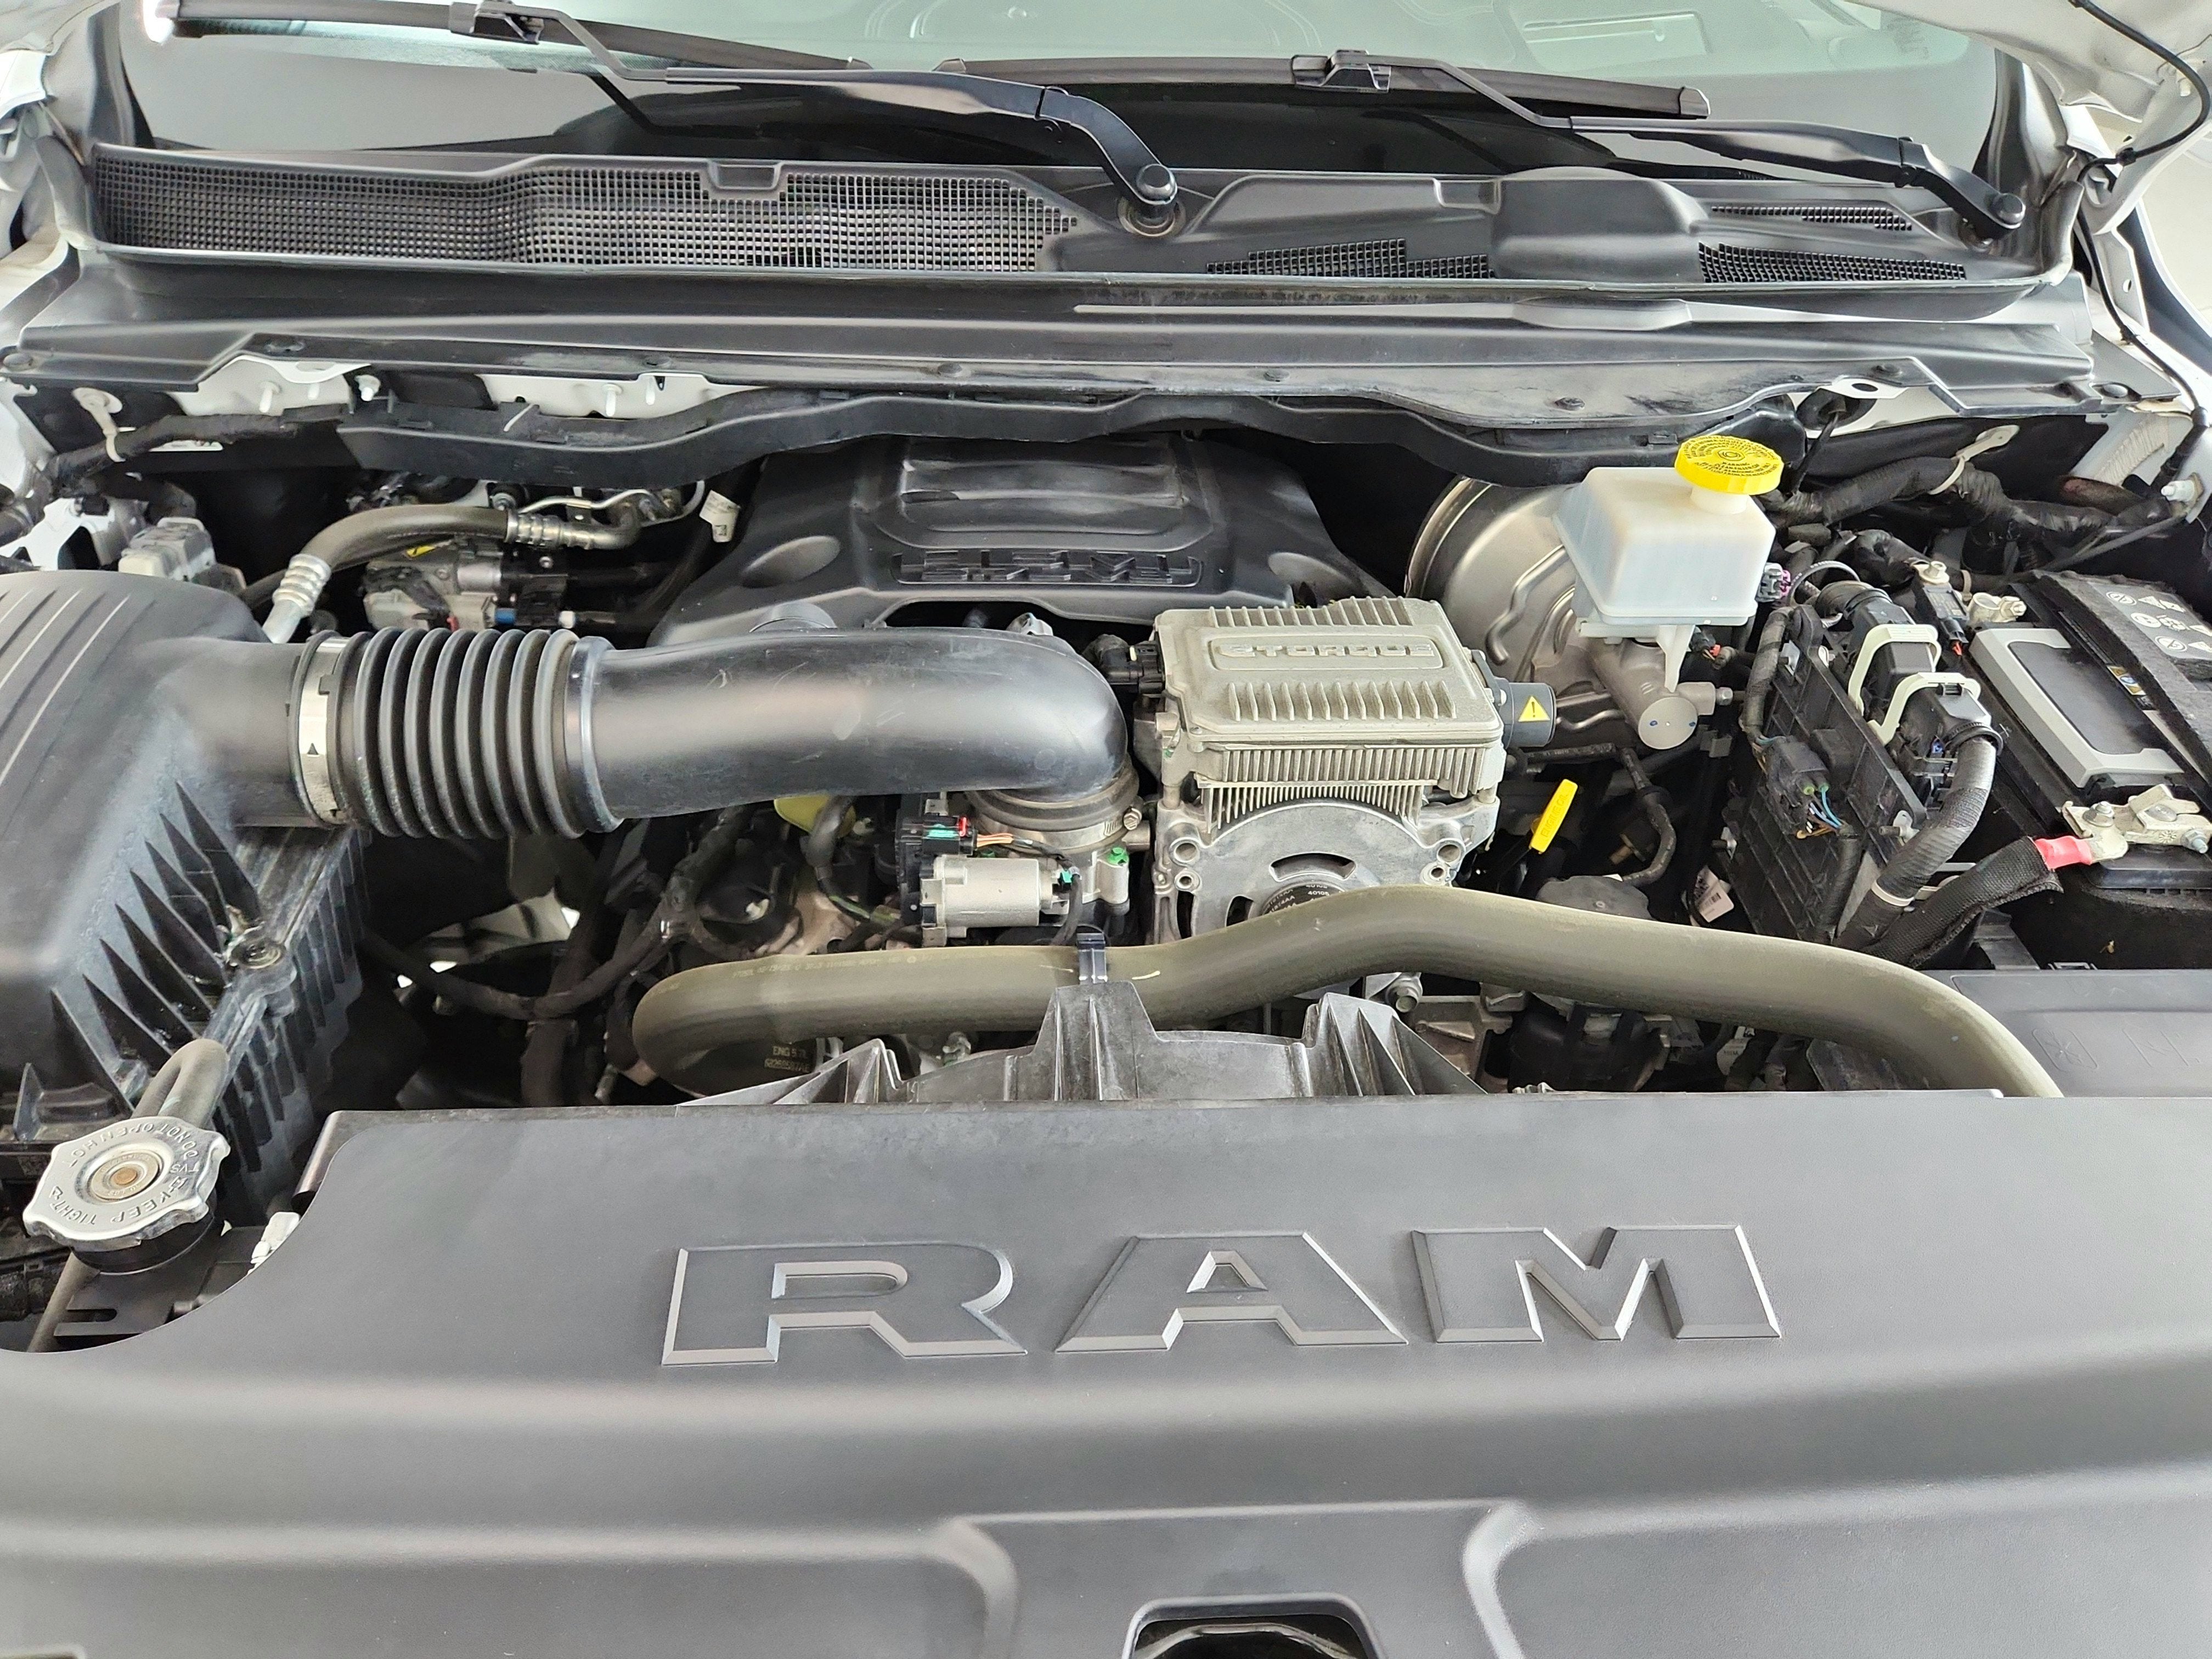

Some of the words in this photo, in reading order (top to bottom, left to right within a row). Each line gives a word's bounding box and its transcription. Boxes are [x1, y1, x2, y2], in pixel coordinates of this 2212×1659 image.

[1541, 806, 1561, 837] ENGINE
[100, 1124, 154, 1142] OPEN
[159, 1124, 191, 1143] NOT
[62, 1139, 98, 1167] HOT
[183, 1142, 198, 1160] DO
[170, 1163, 200, 1173] TVS
[49, 1201, 97, 1225] TIGHT
[111, 1190, 172, 1223] KEEP
[661, 1223, 1784, 1367] RAM
